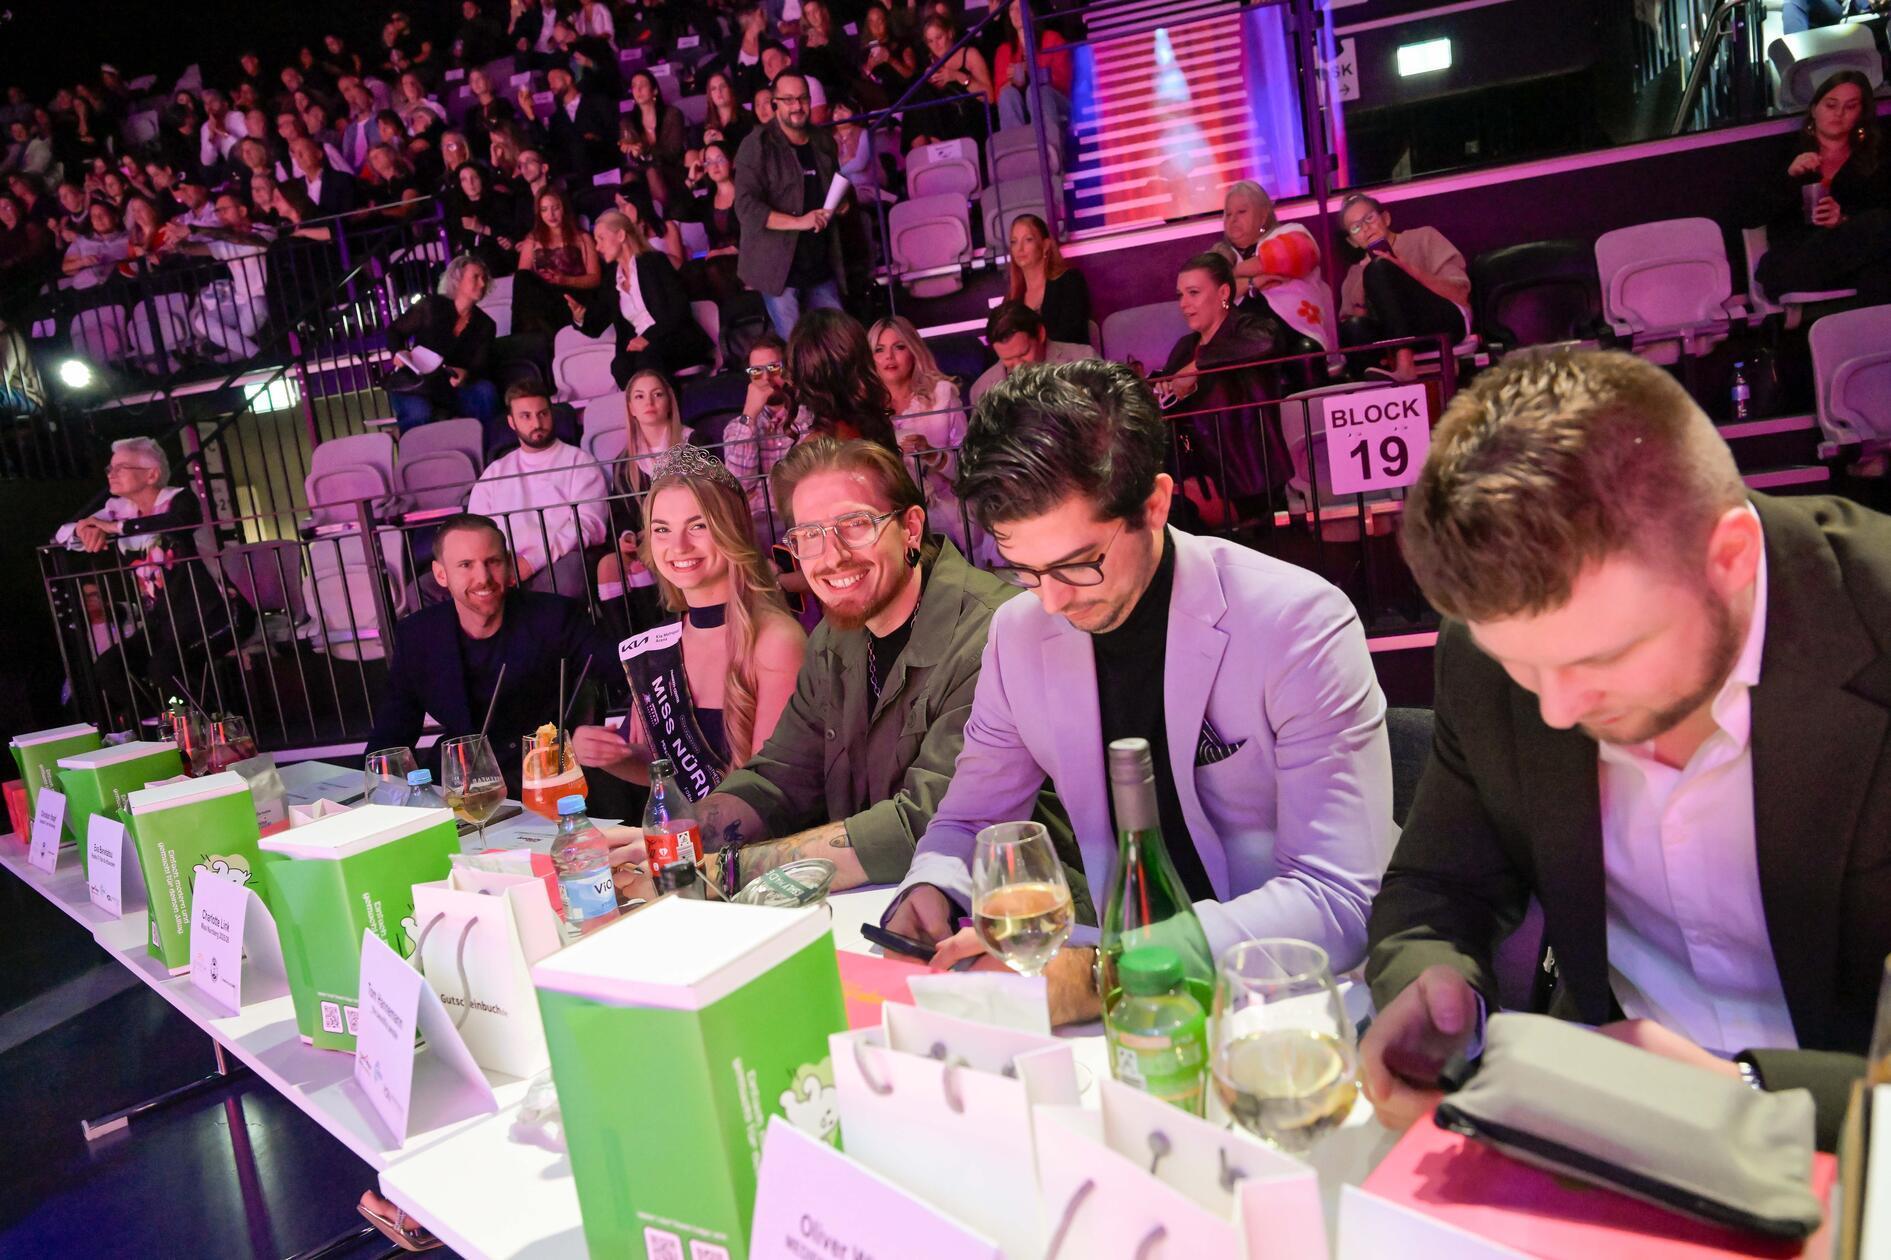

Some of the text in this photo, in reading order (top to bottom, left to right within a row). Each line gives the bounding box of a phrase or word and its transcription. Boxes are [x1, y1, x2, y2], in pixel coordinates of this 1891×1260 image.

[1331, 398, 1420, 429] BLOCK
[1350, 435, 1409, 480] 19
[651, 675, 675, 735] MISS
[800, 1213, 848, 1260] Oliver
